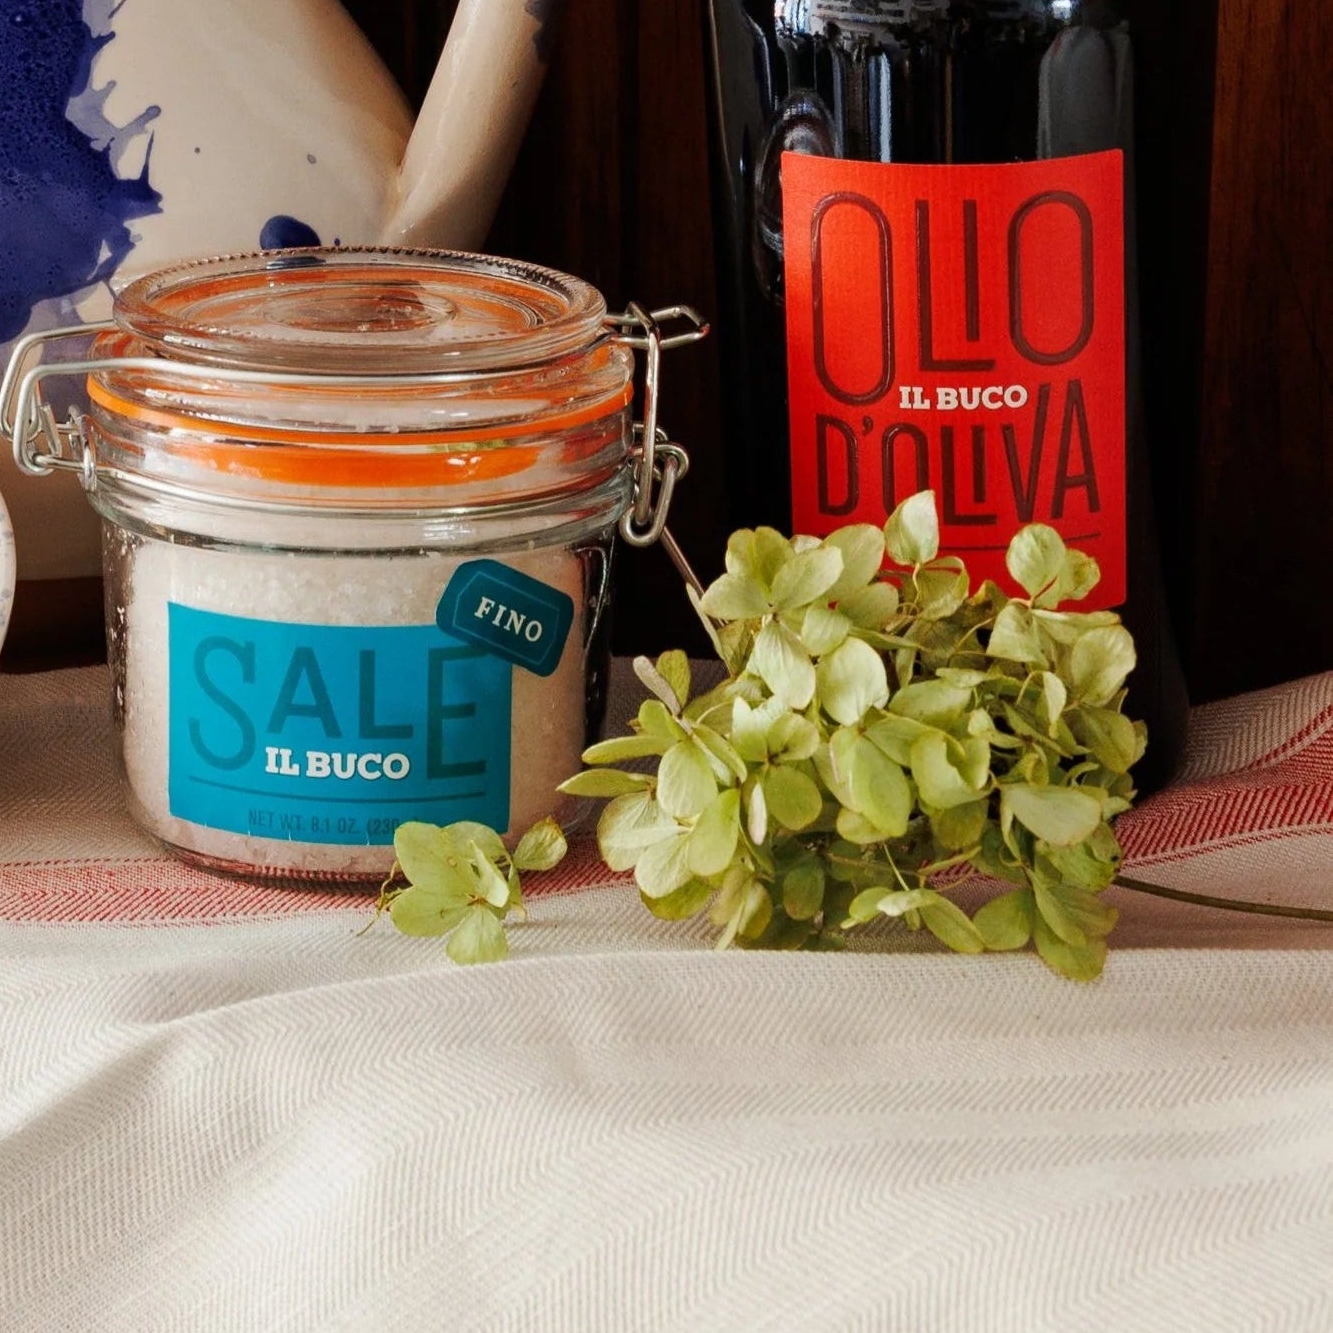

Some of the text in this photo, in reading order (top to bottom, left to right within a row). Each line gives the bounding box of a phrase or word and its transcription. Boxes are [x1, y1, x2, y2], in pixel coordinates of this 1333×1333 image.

[811, 190, 1094, 405] OLIO
[899, 385, 1028, 410] IL BUCO
[815, 379, 1101, 525] D'OLIVA
[474, 596, 543, 642] FINO
[188, 636, 488, 781] SALE
[266, 748, 410, 780] IL BUCO
[248, 809, 274, 827] NET
[279, 814, 305, 832] WT.
[337, 818, 361, 834] OZ.
